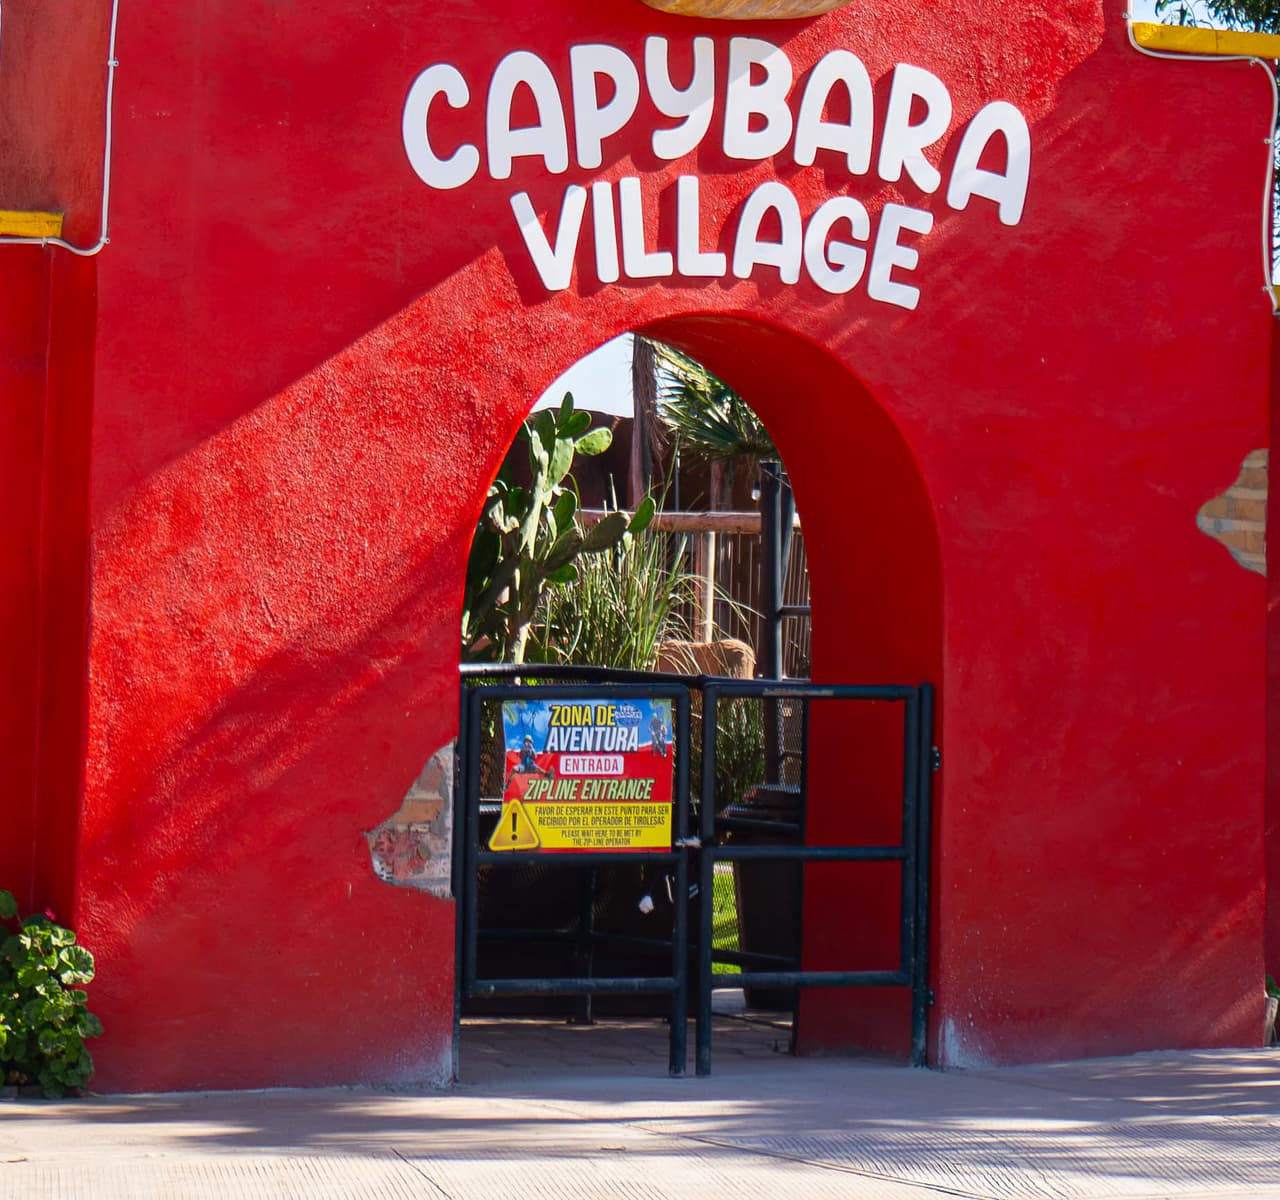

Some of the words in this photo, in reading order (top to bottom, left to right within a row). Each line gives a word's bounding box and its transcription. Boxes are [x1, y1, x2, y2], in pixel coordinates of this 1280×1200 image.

[402, 35, 1032, 226] CAPYBARA
[509, 175, 934, 310] VILLAGE
[551, 706, 592, 727] ZONA
[595, 705, 617, 726] DE
[546, 727, 639, 752] AVENTURA
[564, 758, 618, 772] ENTRADA
[524, 779, 580, 800] ZIPLINE
[581, 779, 655, 800] ENTRANCE
[535, 806, 554, 816] FAVOR
[556, 806, 564, 816] DE
[566, 806, 593, 816] ESPERAR
[594, 806, 602, 816] EN
[604, 806, 619, 816] ESTE
[620, 806, 640, 816] PUNTO
[641, 806, 656, 816] PARA
[657, 806, 669, 816] SER
[538, 816, 567, 826] RECIBIDO
[568, 816, 580, 826] POR
[582, 816, 589, 826] EL
[591, 816, 622, 826] OPERADOR
[624, 816, 632, 826] DE
[633, 816, 665, 825] TIROLESAS
[561, 830, 580, 838] PLEASE
[604, 838, 630, 846] OPERATOR
